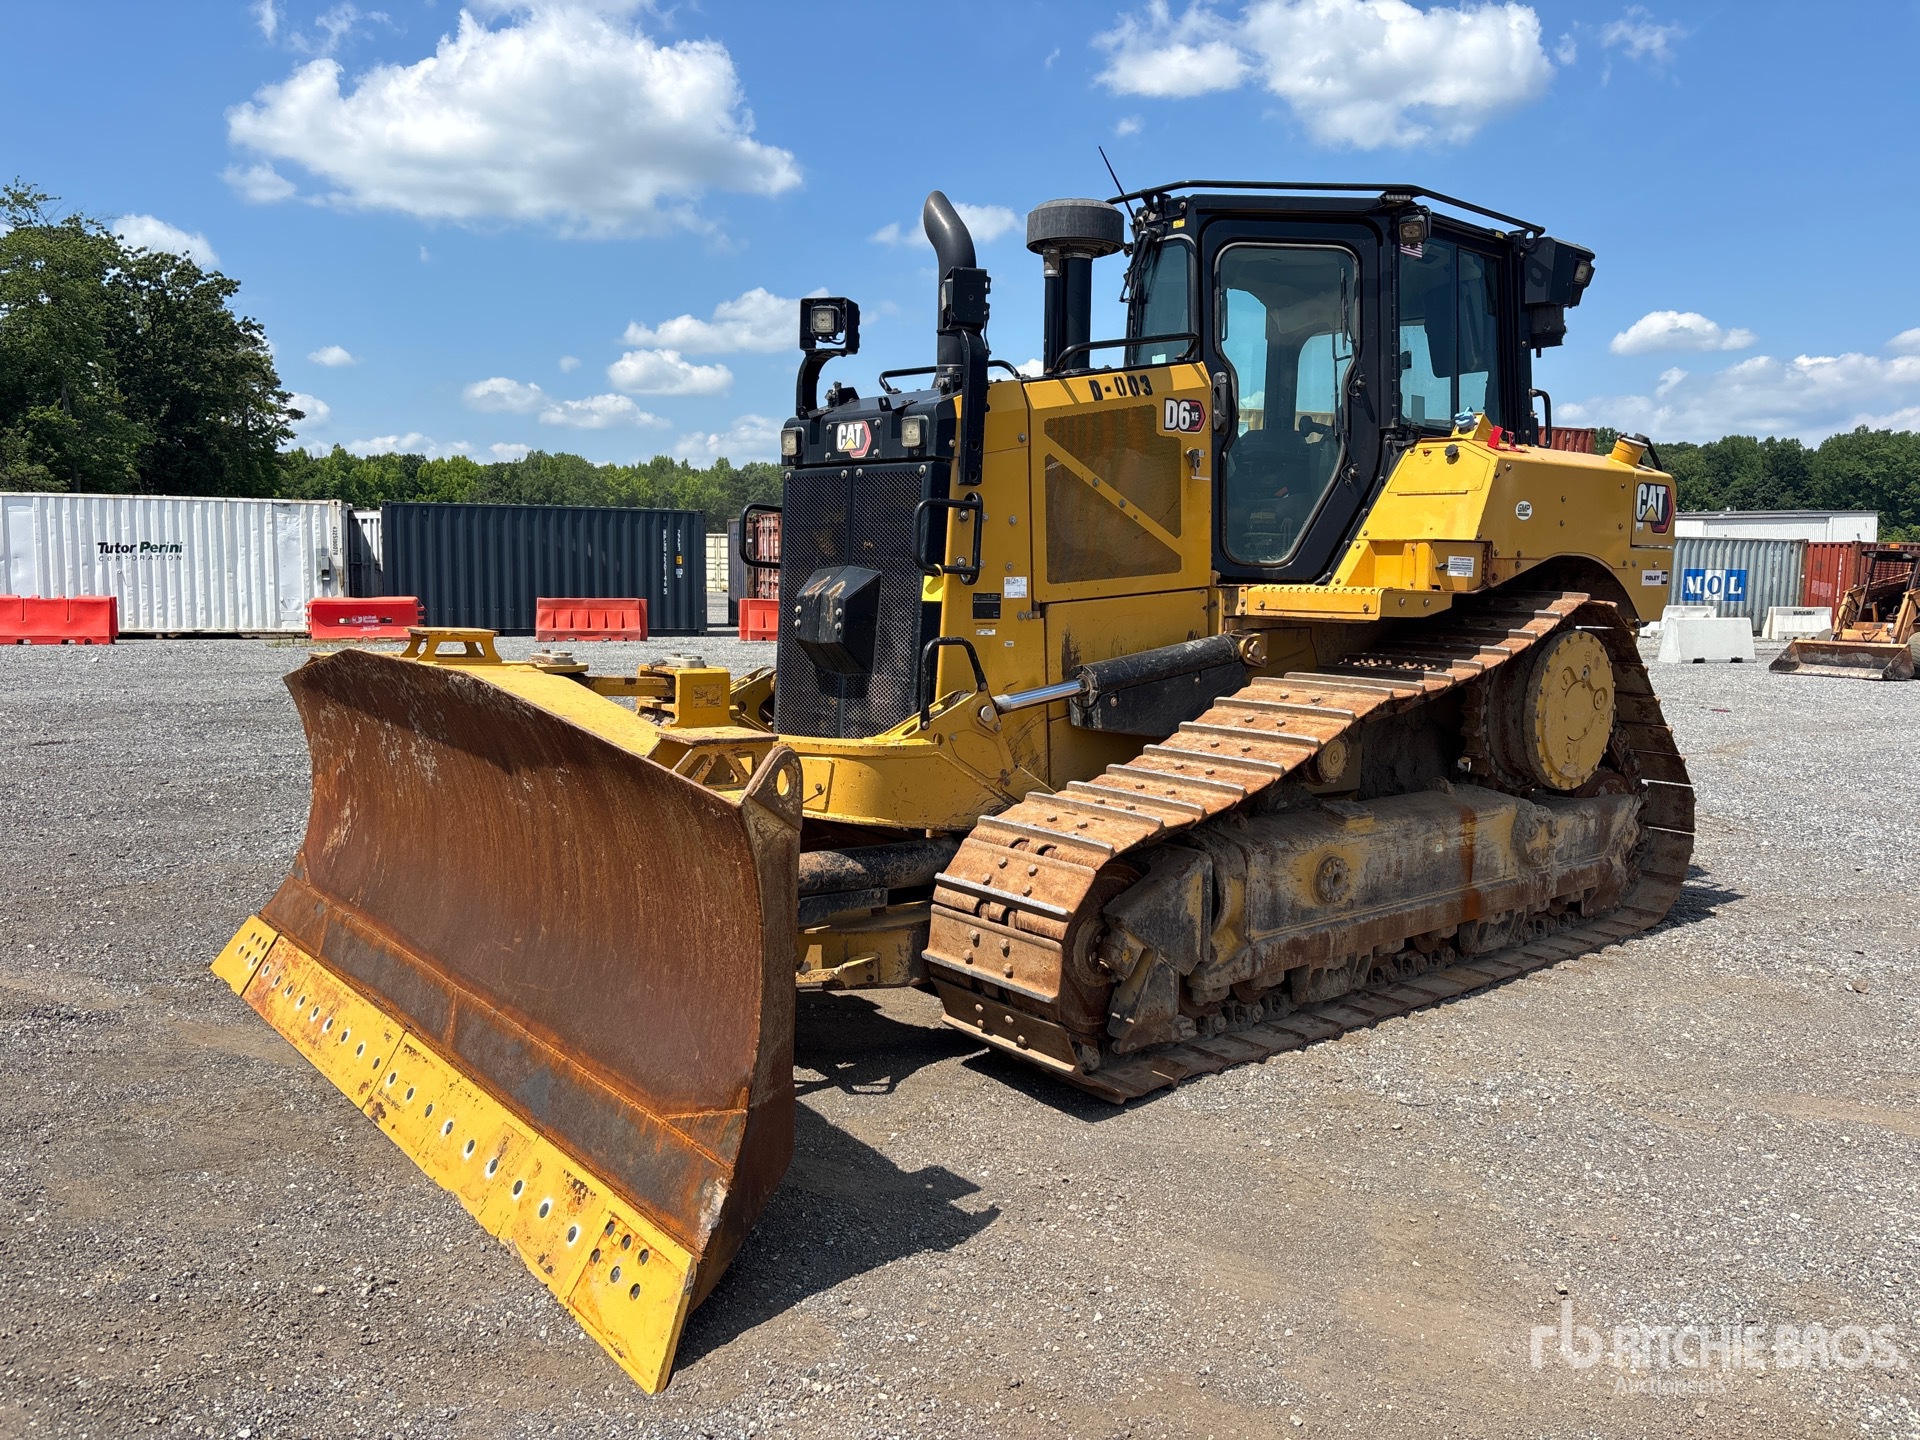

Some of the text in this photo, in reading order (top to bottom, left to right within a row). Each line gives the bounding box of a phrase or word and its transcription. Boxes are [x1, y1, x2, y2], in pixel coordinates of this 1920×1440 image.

[1164, 398, 1191, 431] D6
[837, 423, 863, 450] CAT
[1636, 483, 1667, 522] CAT
[97, 541, 183, 554] Tutor Perini
[1685, 575, 1742, 595] MOL
